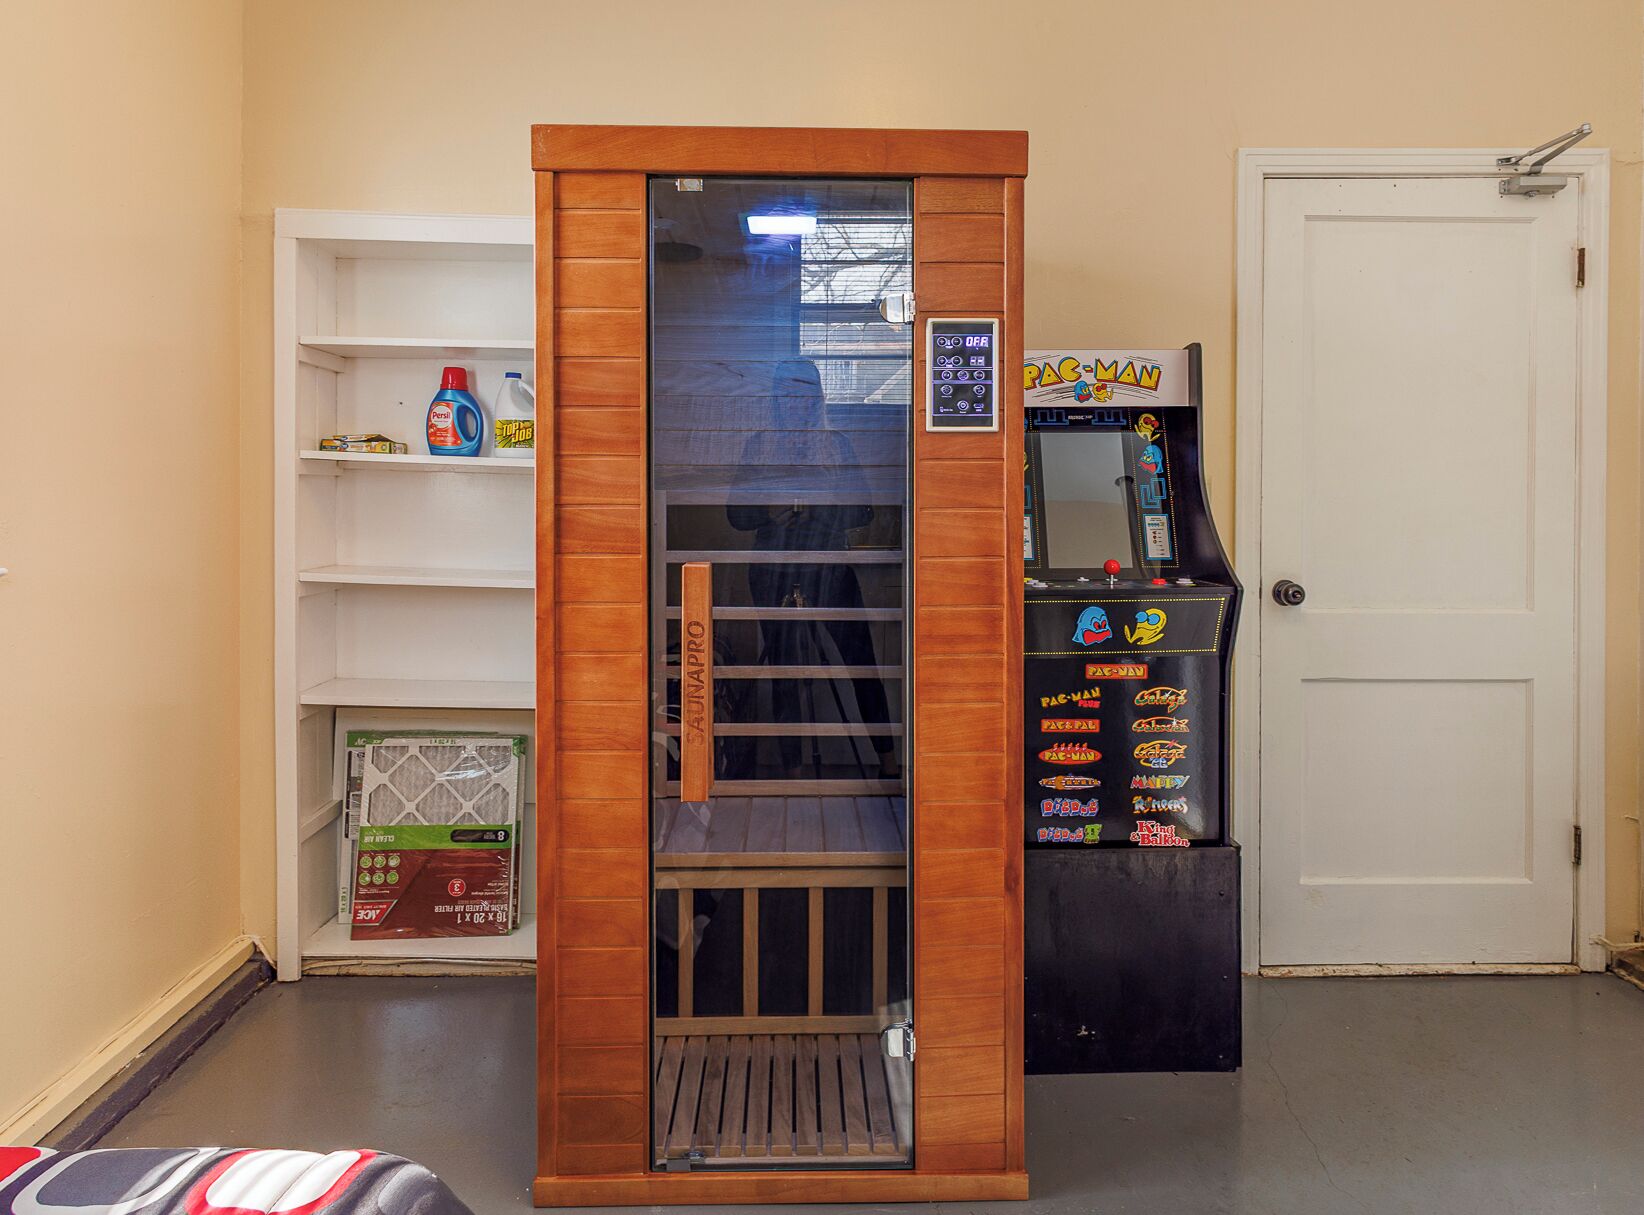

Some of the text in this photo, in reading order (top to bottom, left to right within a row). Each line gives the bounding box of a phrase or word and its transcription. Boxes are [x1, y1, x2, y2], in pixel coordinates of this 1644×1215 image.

[1024, 356, 1161, 391] PAC-MAN
[432, 411, 450, 419] Persil
[503, 422, 519, 436] TOP
[511, 428, 532, 442] JOB
[1088, 666, 1144, 677] PAC-MAN
[687, 620, 705, 745] SAUNAPRO
[1040, 687, 1101, 708] PAC-MAN
[1043, 721, 1065, 730] PAC
[1074, 721, 1096, 730] PAL
[1044, 752, 1095, 761] PAC-MAN
[1130, 775, 1190, 789] MAPPY
[1136, 821, 1175, 836] King
[497, 830, 505, 841] 8
[1130, 832, 1190, 847] & Balloon
[454, 883, 460, 891] 3
[455, 904, 464, 912] AIR
[466, 904, 490, 912] PLEATED
[490, 903, 508, 912] BASIC
[356, 909, 381, 920] ACE
[473, 913, 485, 923] 20
[496, 912, 507, 922] 16
